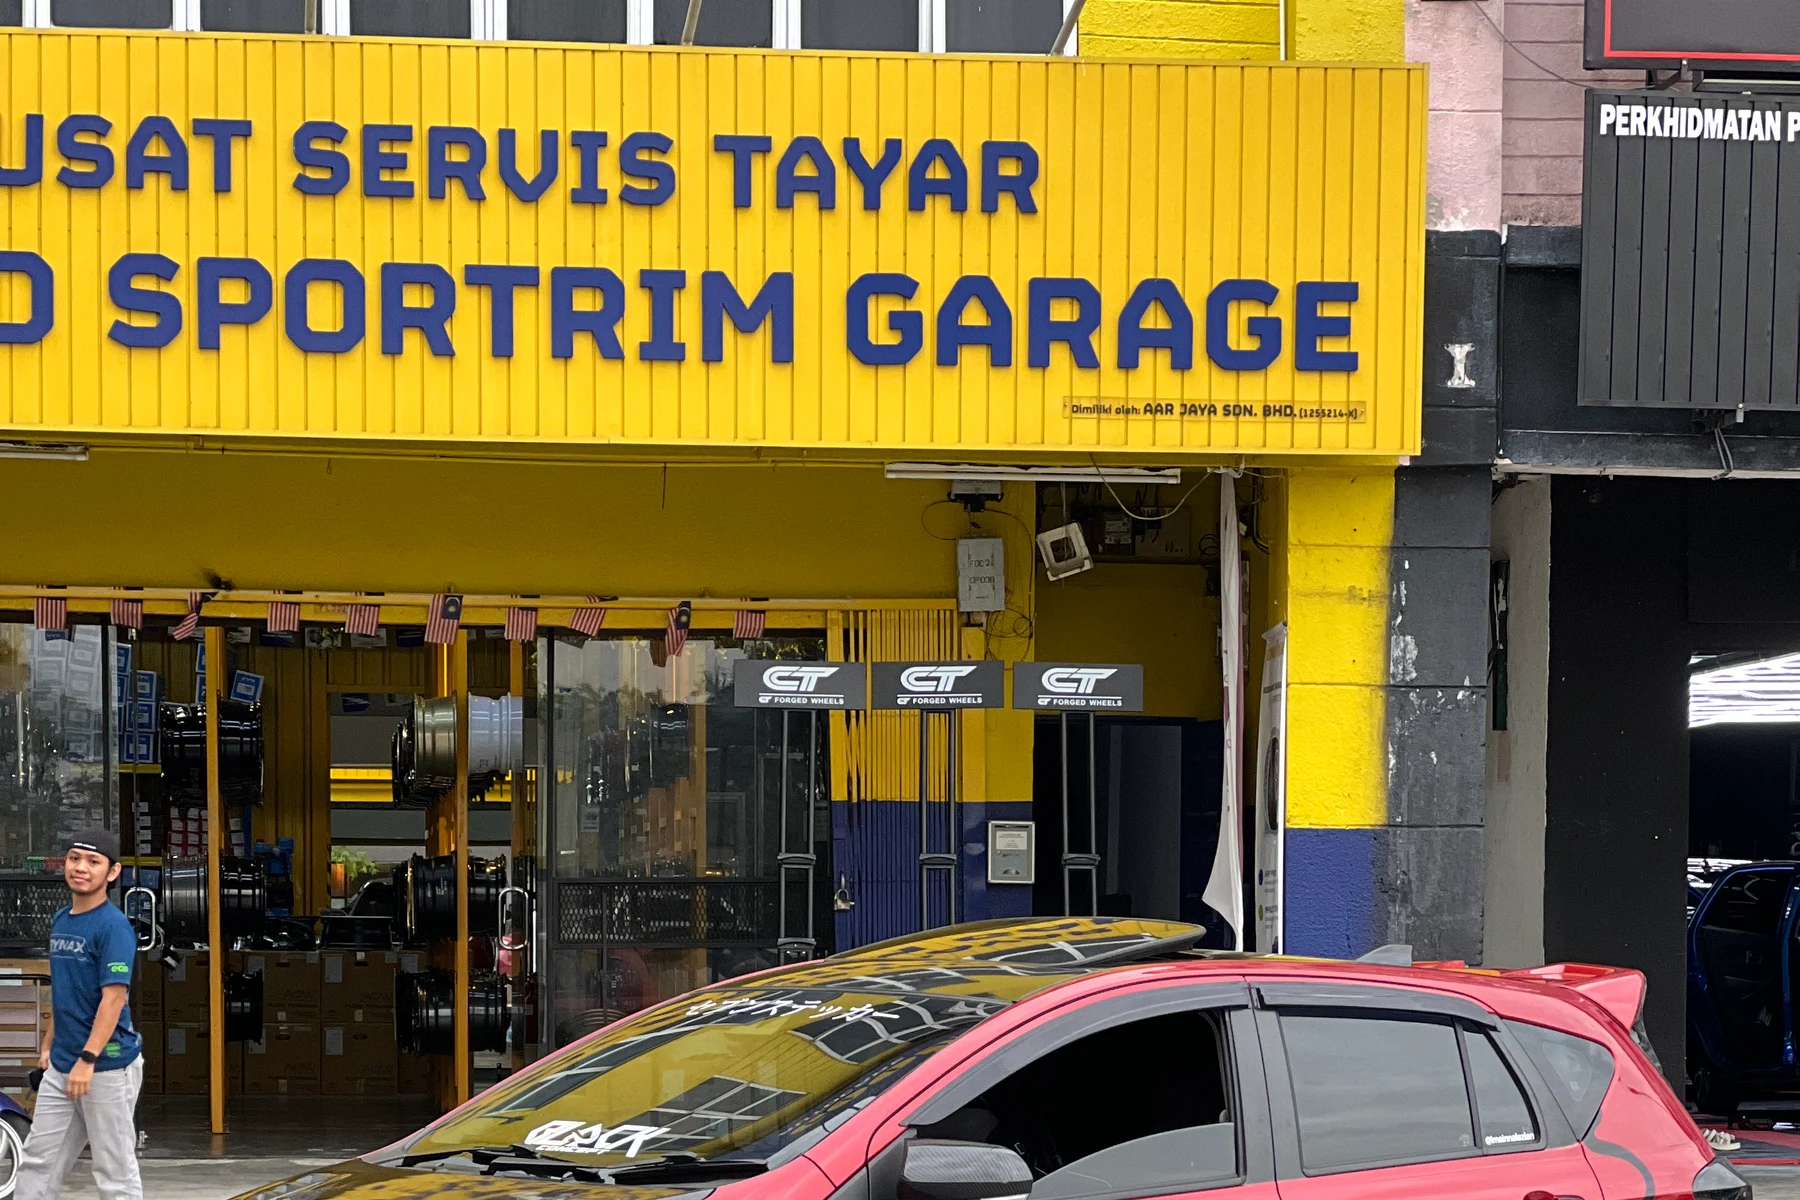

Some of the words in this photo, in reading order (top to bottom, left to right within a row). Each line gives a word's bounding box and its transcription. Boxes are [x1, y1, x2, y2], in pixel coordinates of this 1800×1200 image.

[1600, 103, 1761, 142] PERKHIDMATAN
[293, 120, 676, 206] SERVIS
[714, 134, 1039, 213] TAYAR
[108, 253, 793, 363] SPORTRIM
[846, 272, 1359, 372] GARAGE
[1071, 404, 1112, 415] Dimiliki
[1115, 405, 1141, 415] oleh:
[1143, 403, 1174, 416] AAR
[1180, 403, 1218, 416] JAYA
[1222, 404, 1257, 417] SDN.
[1263, 404, 1297, 418] BHD.
[774, 696, 808, 704] FORGED
[811, 697, 845, 705] WHEELS
[949, 696, 983, 704] WHEELS
[1053, 698, 1086, 706] FORGED
[1089, 699, 1123, 707] WHEELS
